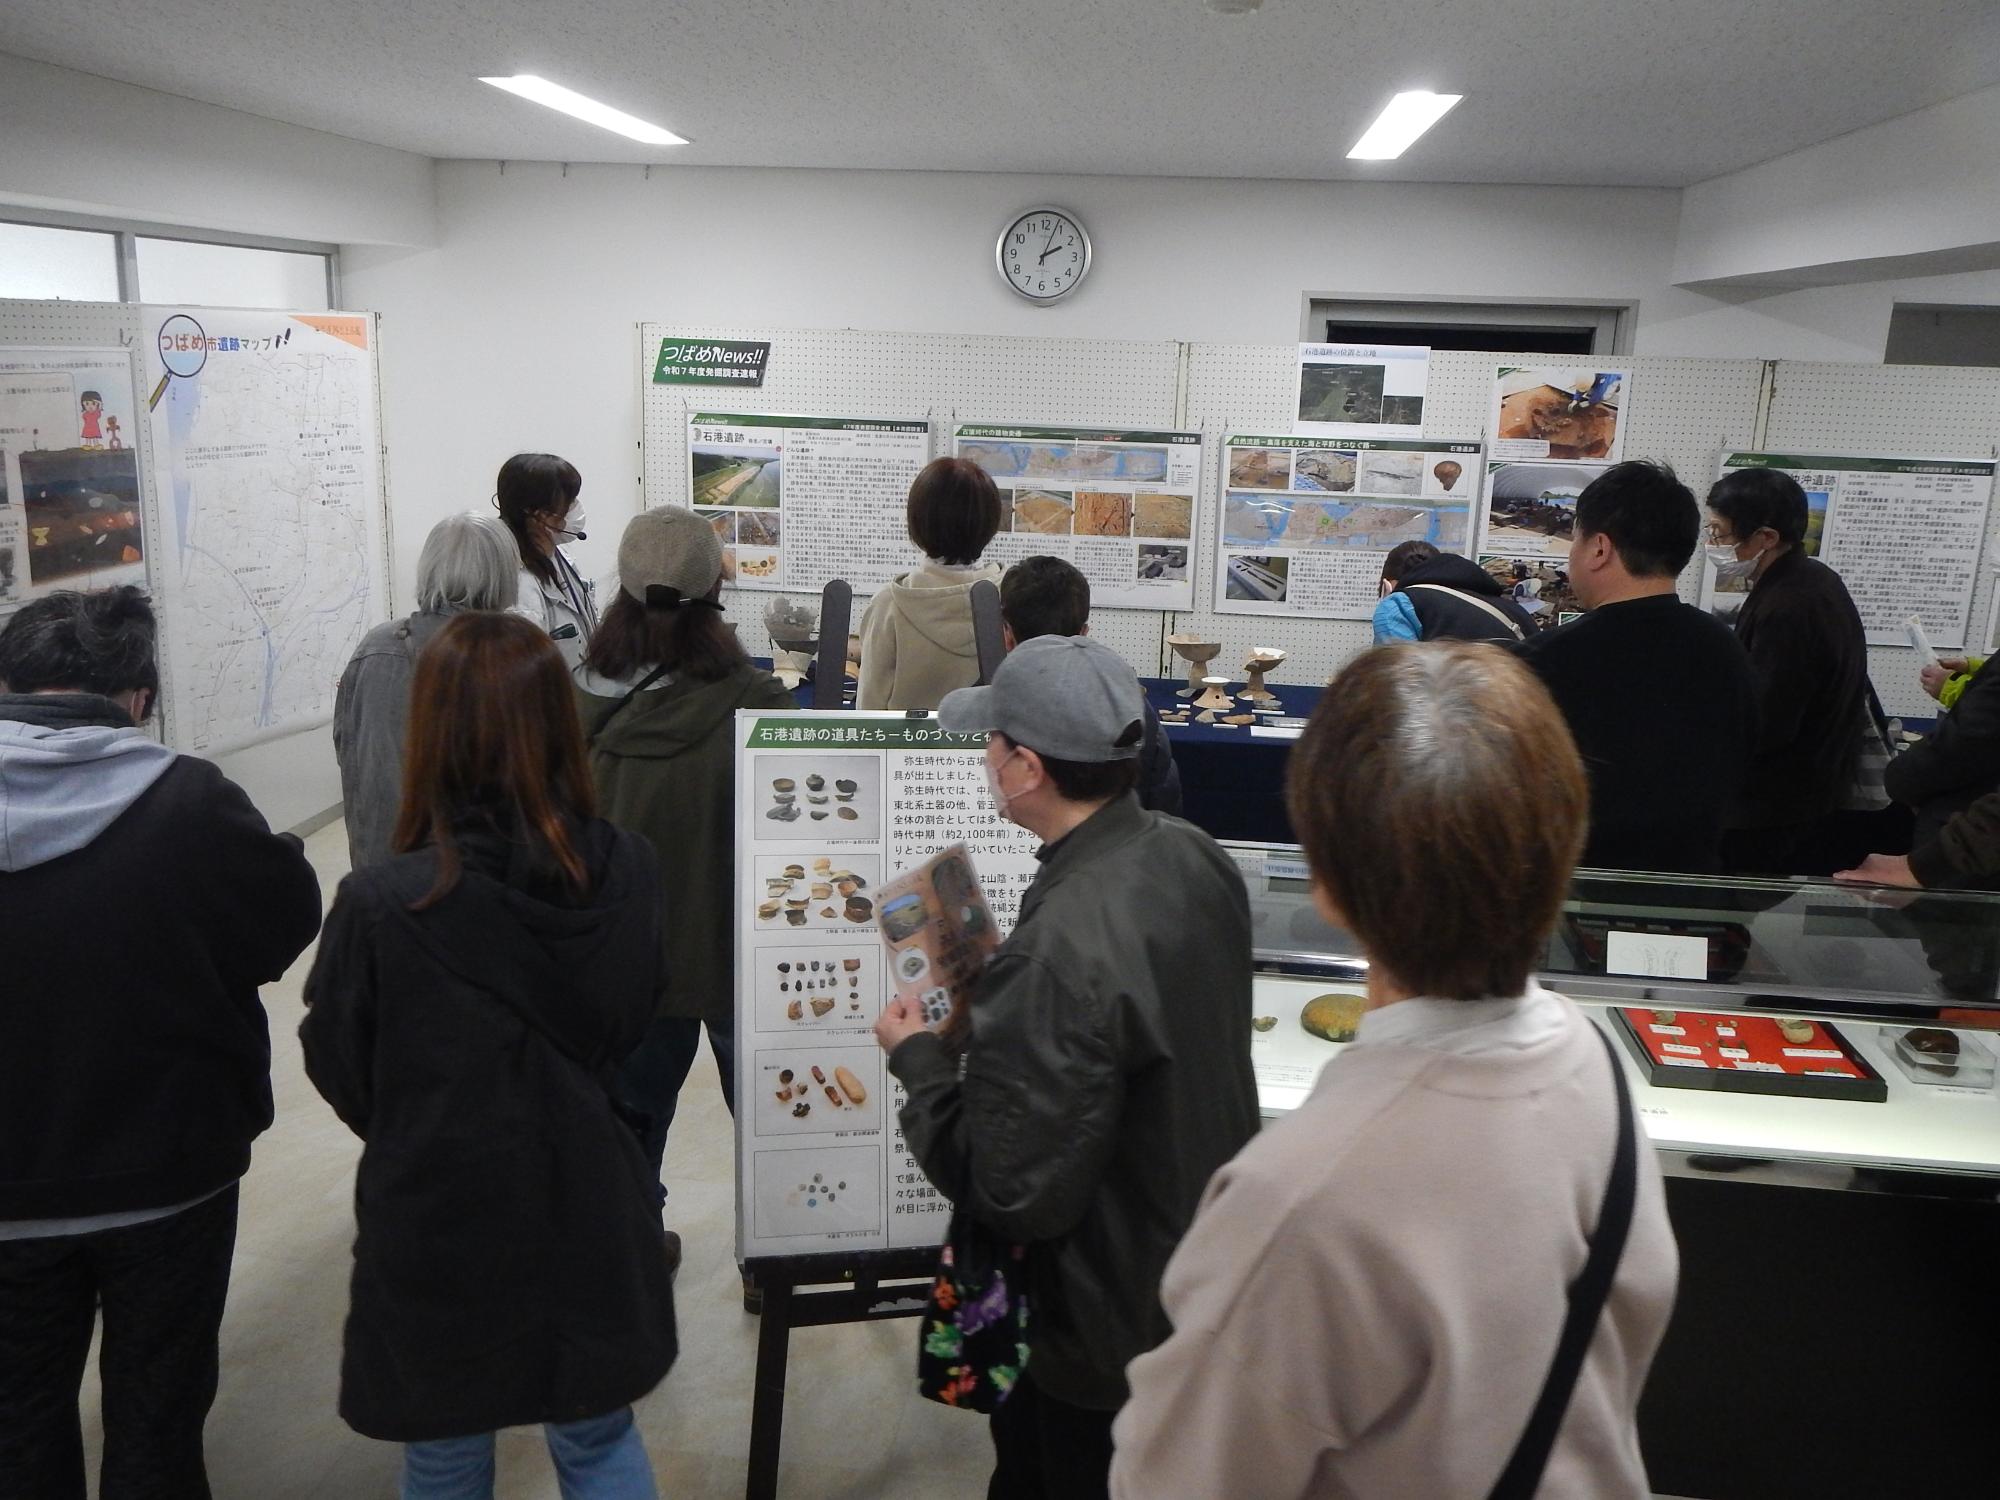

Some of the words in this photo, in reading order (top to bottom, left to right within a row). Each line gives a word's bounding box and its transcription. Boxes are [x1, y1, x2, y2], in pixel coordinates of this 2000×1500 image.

[1027, 223, 1036, 232] 11
[1041, 220, 1050, 230] 12
[1059, 225, 1062, 235] 1
[1016, 234, 1025, 244] 10
[1068, 236, 1074, 246] 2
[1010, 248, 1017, 259] 9
[1072, 252, 1078, 262] 3
[1014, 264, 1020, 274] 8
[1065, 268, 1071, 278] 4
[1025, 276, 1031, 286] 7
[1038, 281, 1045, 291] 6
[1054, 278, 1061, 287] 5
[703, 431, 745, 443] 石港遺跡
[894, 770, 981, 781] 具が出土しました。
[894, 860, 908, 870] す。
[894, 1143, 911, 1153] 祭
[895, 1173, 928, 1183] で盛ん
